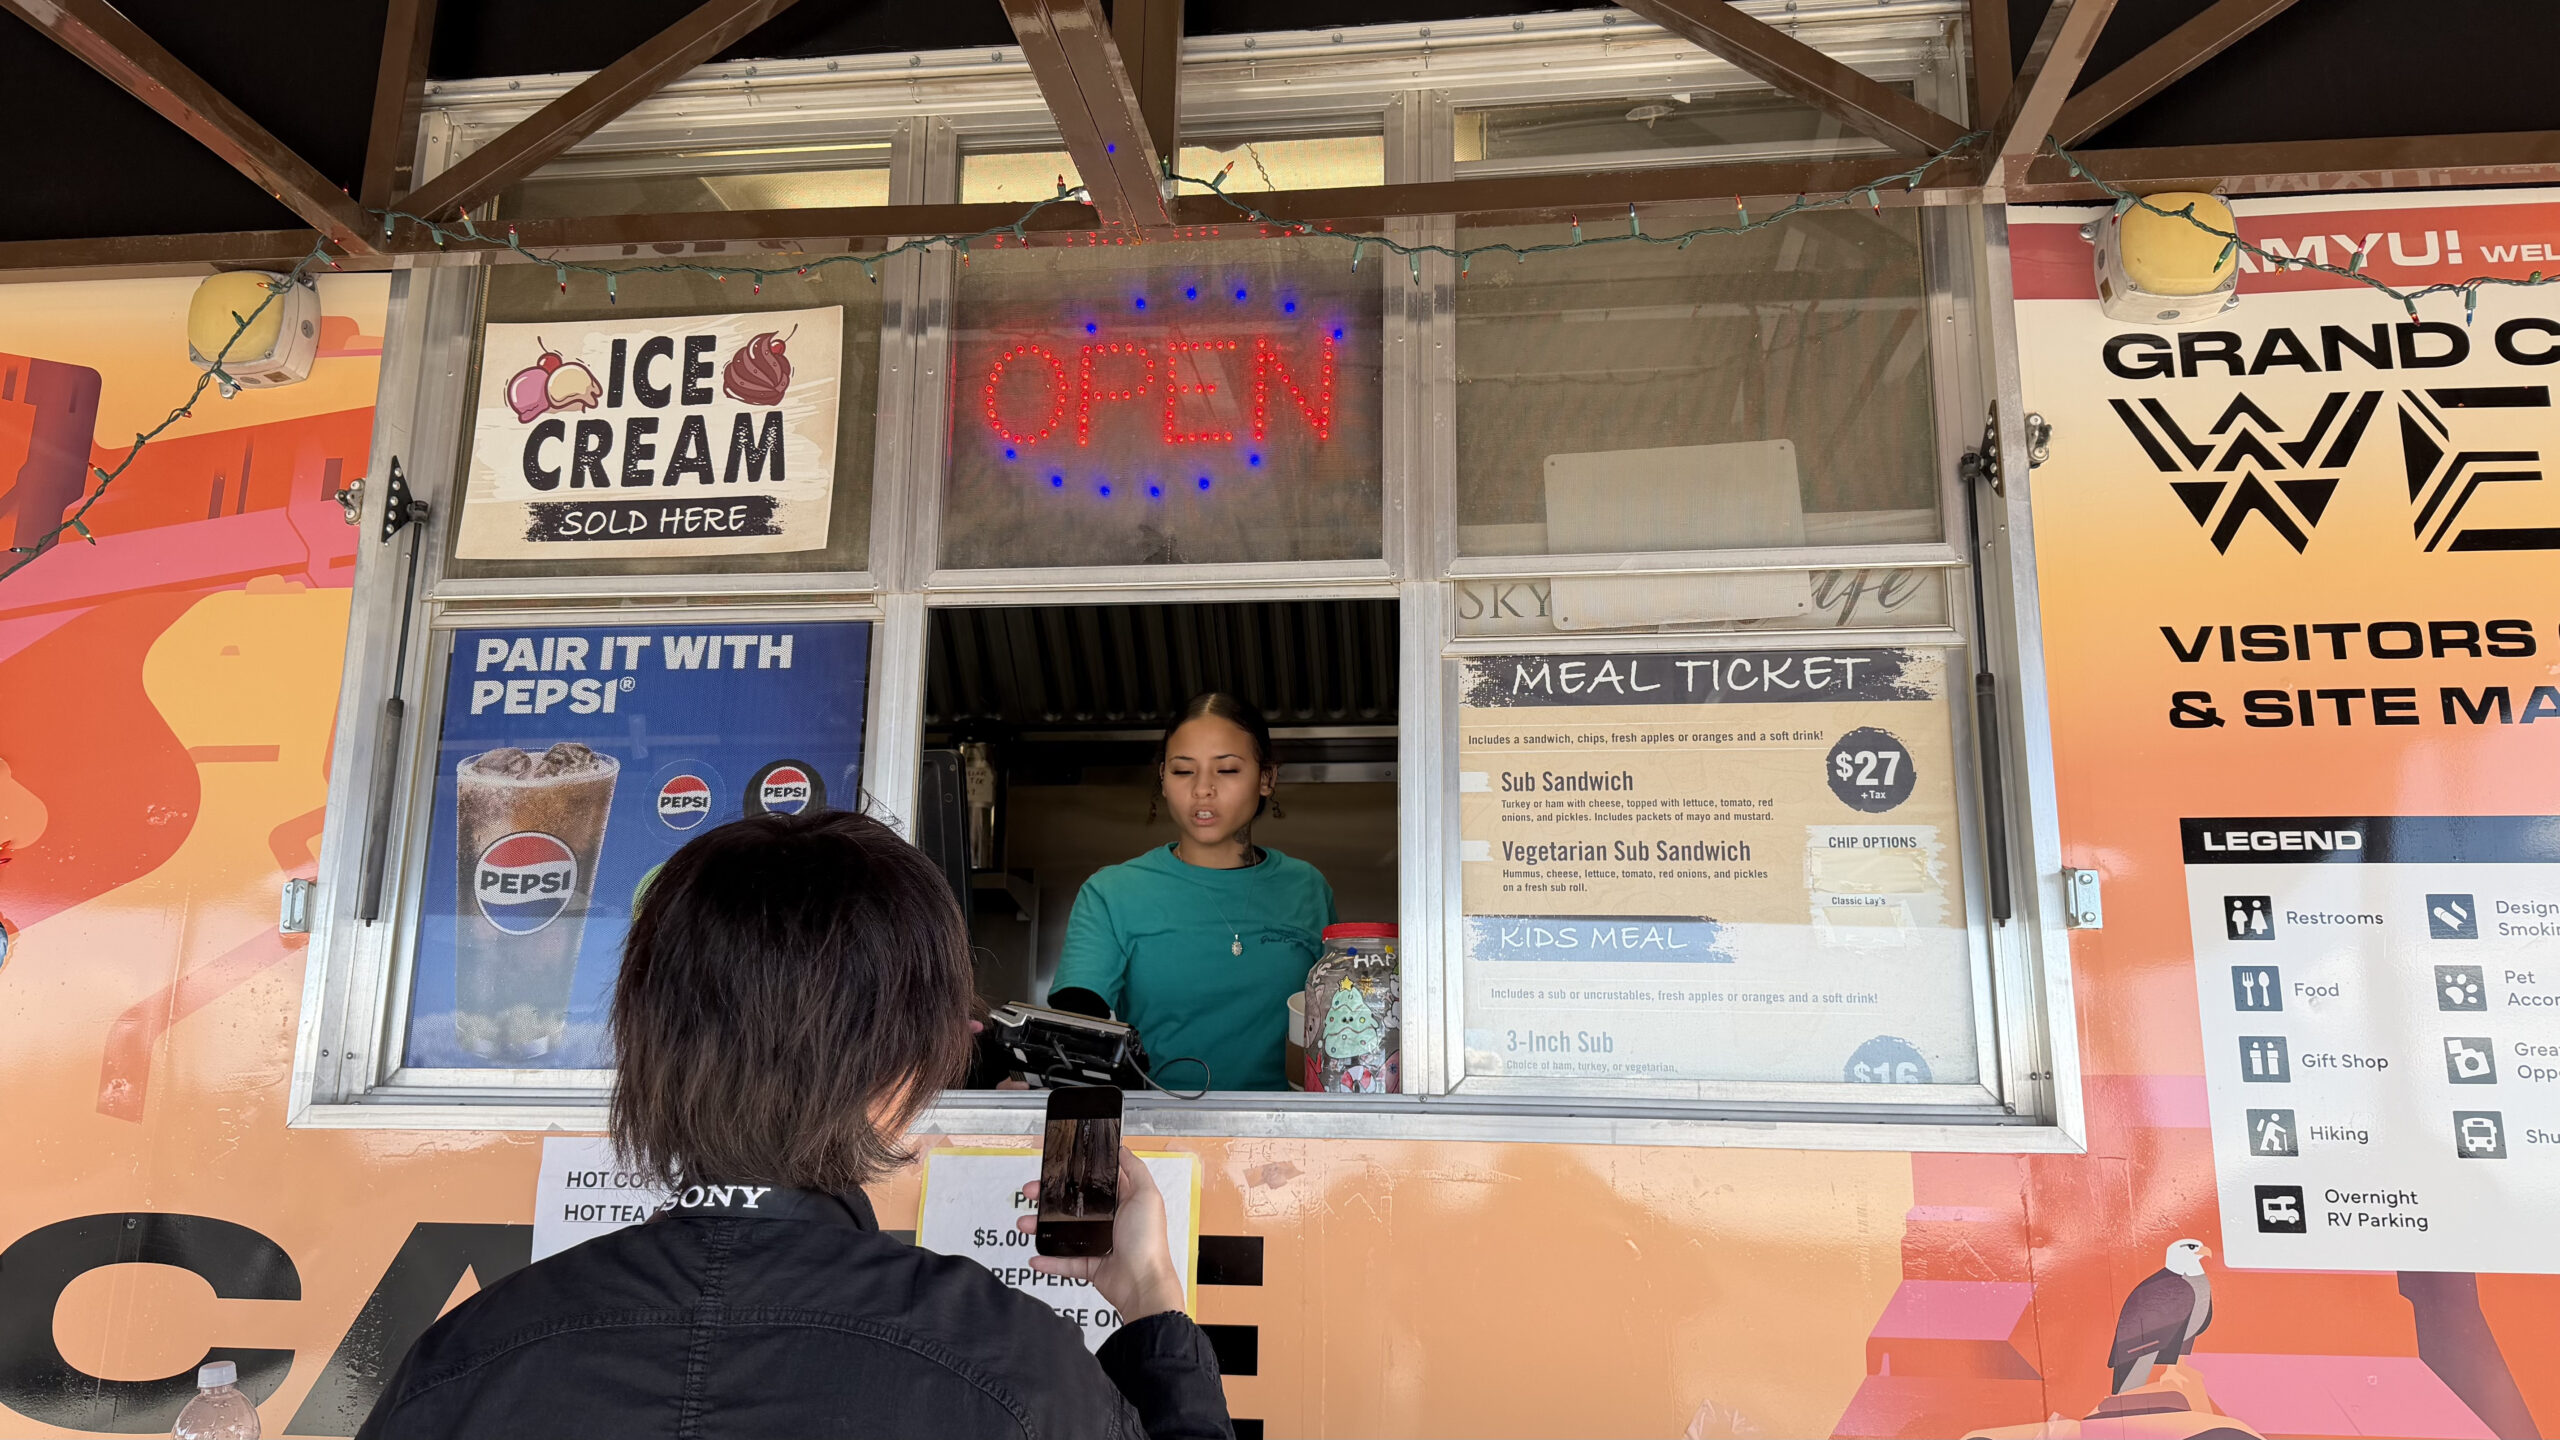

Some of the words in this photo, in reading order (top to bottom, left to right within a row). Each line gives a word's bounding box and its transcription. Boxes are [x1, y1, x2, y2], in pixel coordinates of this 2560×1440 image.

[2102, 321, 2471, 380] GRAND
[607, 334, 717, 409] ICE
[984, 335, 1335, 446] OPEN
[522, 411, 786, 491] CREAM
[559, 509, 648, 536] SOLD
[660, 505, 748, 535] HERE
[1458, 581, 1552, 621] SKY
[2159, 619, 2537, 664] VISITORS
[475, 636, 590, 674] PAIR
[600, 636, 652, 672] IT
[663, 634, 795, 671] WITH
[1511, 659, 1661, 697] MEAL
[1675, 655, 1872, 694] TICKET
[470, 675, 636, 716] PEPSI®
[2168, 692, 2226, 729] &
[2243, 688, 2420, 728] SITE
[1468, 735, 1511, 745] Includes
[1523, 734, 1574, 746] sandwich,
[1577, 734, 1608, 746] chips,
[1611, 733, 1638, 744] fresh
[1640, 733, 1675, 745] apples
[1678, 735, 1689, 743] or
[1692, 735, 1734, 745] oranges
[1737, 731, 1757, 743] and
[1759, 734, 1766, 742] a
[1769, 731, 1789, 742] soft
[1792, 730, 1824, 742] drink!
[1835, 751, 1901, 787] $27
[1501, 771, 1535, 792] Sub
[1542, 770, 1634, 792] Sandwich
[659, 794, 710, 809] PEPSI
[763, 785, 808, 800] PEPSI
[1501, 799, 1531, 810] Turkey
[1533, 801, 1543, 809] or
[1545, 799, 1564, 808] ham
[1567, 798, 1586, 808] with
[1588, 799, 1624, 809] cheese,
[1627, 799, 1658, 810] topped
[1660, 798, 1679, 808] with
[1683, 798, 1718, 809] lettuce,
[1720, 798, 1755, 809] tomato,
[1758, 798, 1774, 807] red
[1501, 812, 1534, 823] onions,
[1536, 812, 1553, 822] and
[1556, 812, 1592, 823] pickles.
[1594, 812, 1633, 822] Includes
[1636, 812, 1672, 823] packets
[1674, 811, 1684, 821] of
[1686, 813, 1711, 823] mayo
[1713, 811, 1731, 821] and
[1734, 811, 1774, 821] mustard.
[1828, 836, 1859, 849] CHIP
[1862, 836, 1918, 849] OPTIONS
[2203, 830, 2363, 852] LEGEND
[1502, 840, 1607, 866] Vegetarian
[1614, 840, 1650, 862] Sub
[1656, 839, 1751, 862] Sandwich
[480, 867, 570, 895] PEPSI
[1502, 869, 1543, 880] Hummus,
[1546, 869, 1582, 880] cheese,
[1584, 869, 1619, 880] lettuce,
[1621, 869, 1656, 880] tomato,
[1658, 868, 1674, 879] red
[1676, 869, 1711, 880] onions,
[1713, 868, 1731, 879] and
[1734, 868, 1768, 880] pickles
[1502, 885, 1514, 893] on
[1516, 885, 1522, 893] a
[1524, 882, 1548, 892] fresh
[1550, 882, 1567, 892] sub
[1569, 882, 1588, 892] roll.
[1831, 896, 1862, 906] Classic
[1865, 896, 1886, 907] Lay's
[2286, 910, 2384, 926] Restrooms
[1500, 926, 1579, 949] KIDS
[1590, 926, 1689, 951] MEAL
[2504, 970, 2536, 985] Pet
[1491, 988, 1535, 1000] Includes
[1538, 991, 1545, 1000] a
[1548, 989, 1566, 1000] sub
[1570, 991, 1580, 1001] or
[1583, 989, 1655, 1002] uncrustables,
[1657, 990, 1685, 1002] fresh
[1688, 992, 1724, 1003] apples
[1727, 993, 1738, 1002] or
[1742, 993, 1785, 1005] oranges
[1788, 992, 1808, 1003] and
[1812, 995, 1819, 1003] a
[1822, 992, 1843, 1004] soft
[1846, 992, 1878, 1004] drink!
[2294, 982, 2340, 998] Food
[1506, 1029, 1571, 1052] 3-Inch
[1578, 1030, 1614, 1053] Sub
[1506, 1060, 1538, 1071] Choice
[1540, 1060, 1550, 1071] of
[1552, 1060, 1576, 1073] ham,
[1578, 1061, 1610, 1073] turkey,
[1612, 1063, 1623, 1072] or
[2301, 1052, 2338, 1069] Gift
[2342, 1053, 2389, 1074] Shop
[2517, 1065, 2560, 1083] Opp
[2310, 1125, 2369, 1145] Hiking
[567, 1171, 609, 1189] HOT
[614, 1172, 646, 1189] CO
[661, 1184, 772, 1210] SONY
[2324, 1188, 2419, 1207] Overnight
[564, 1204, 606, 1222] HOT
[610, 1205, 646, 1222] TEA
[2327, 1212, 2353, 1228] RV
[2358, 1212, 2429, 1232] Parking
[973, 1227, 1030, 1248] $5.00
[991, 1268, 1095, 1287] PEPPERO
